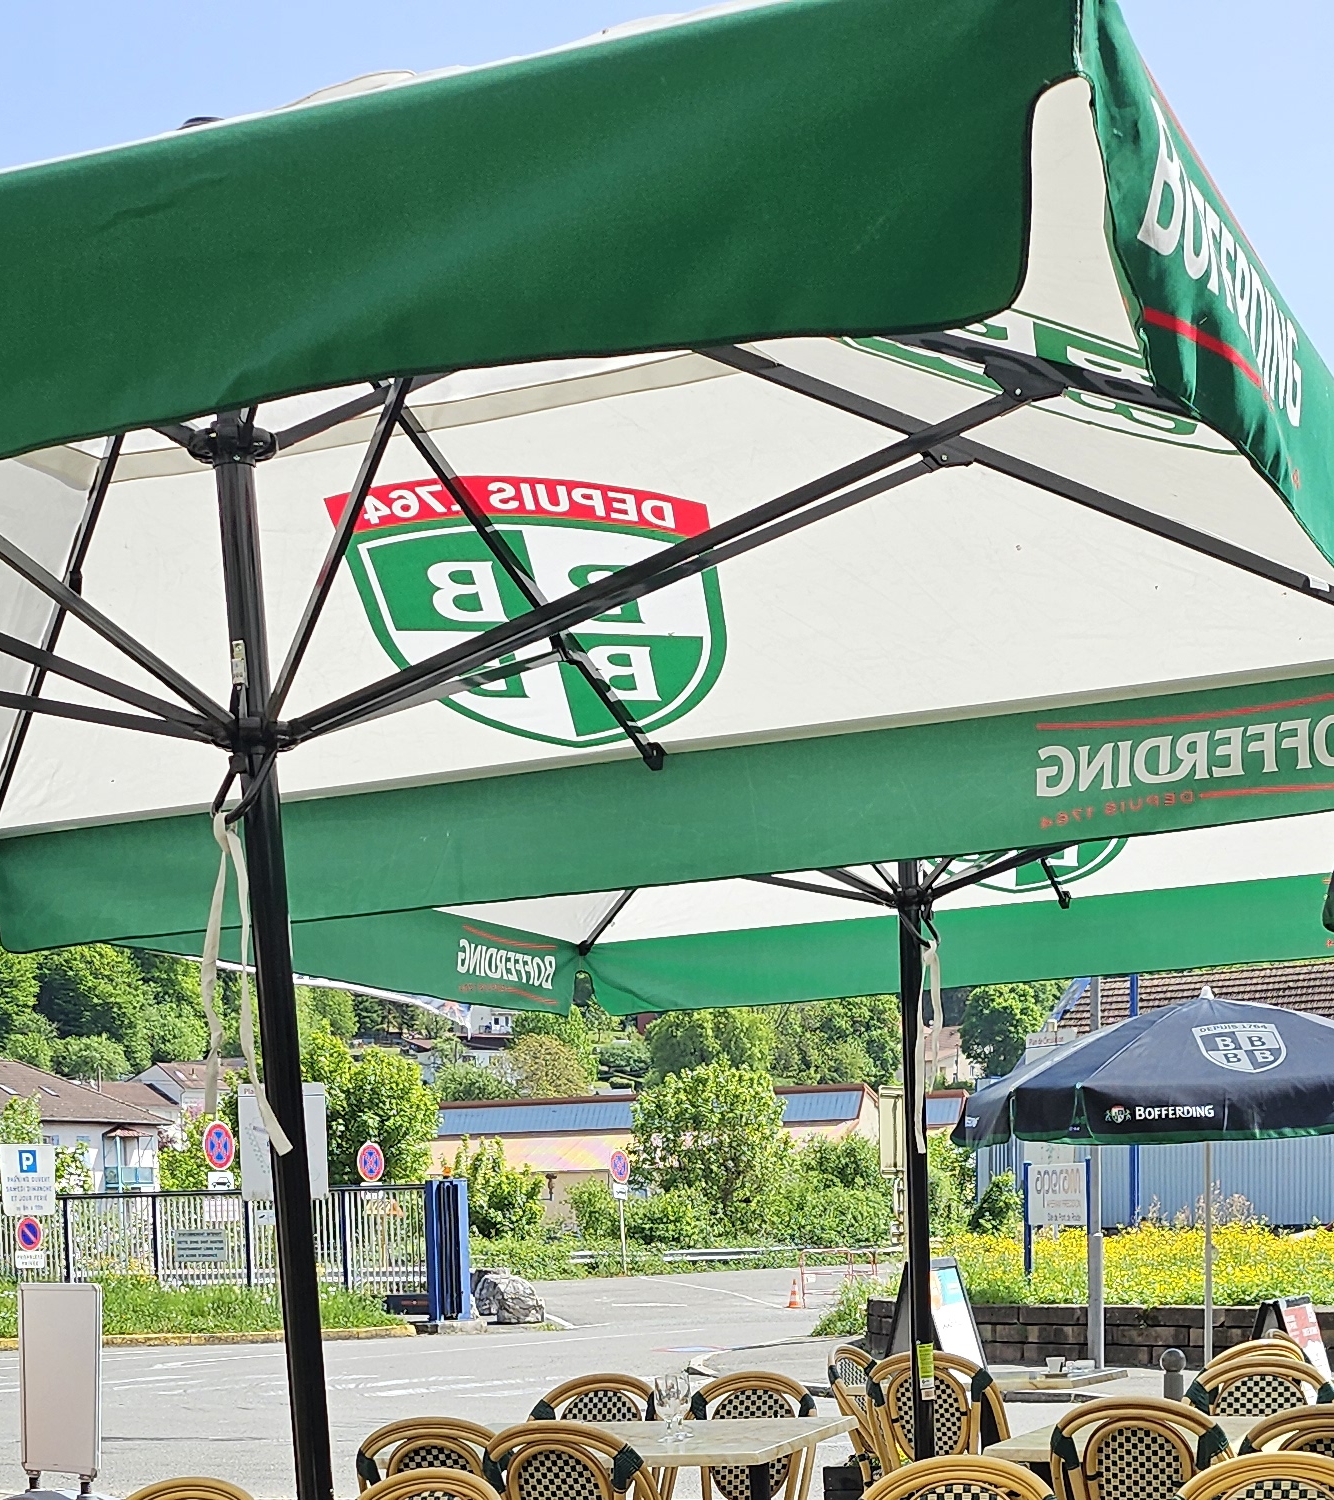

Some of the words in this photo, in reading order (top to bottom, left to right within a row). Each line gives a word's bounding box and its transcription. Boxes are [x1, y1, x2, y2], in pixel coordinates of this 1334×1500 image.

[1199, 1024, 1239, 1033] DEPUIS
[1215, 1037, 1236, 1050] B
[1247, 1035, 1266, 1047] B
[1223, 1053, 1242, 1064] B
[1253, 1050, 1274, 1062] B
[1135, 1105, 1215, 1121] BOFFERDING
[22, 1153, 34, 1170] P
[1035, 1168, 1082, 1208] aperam
